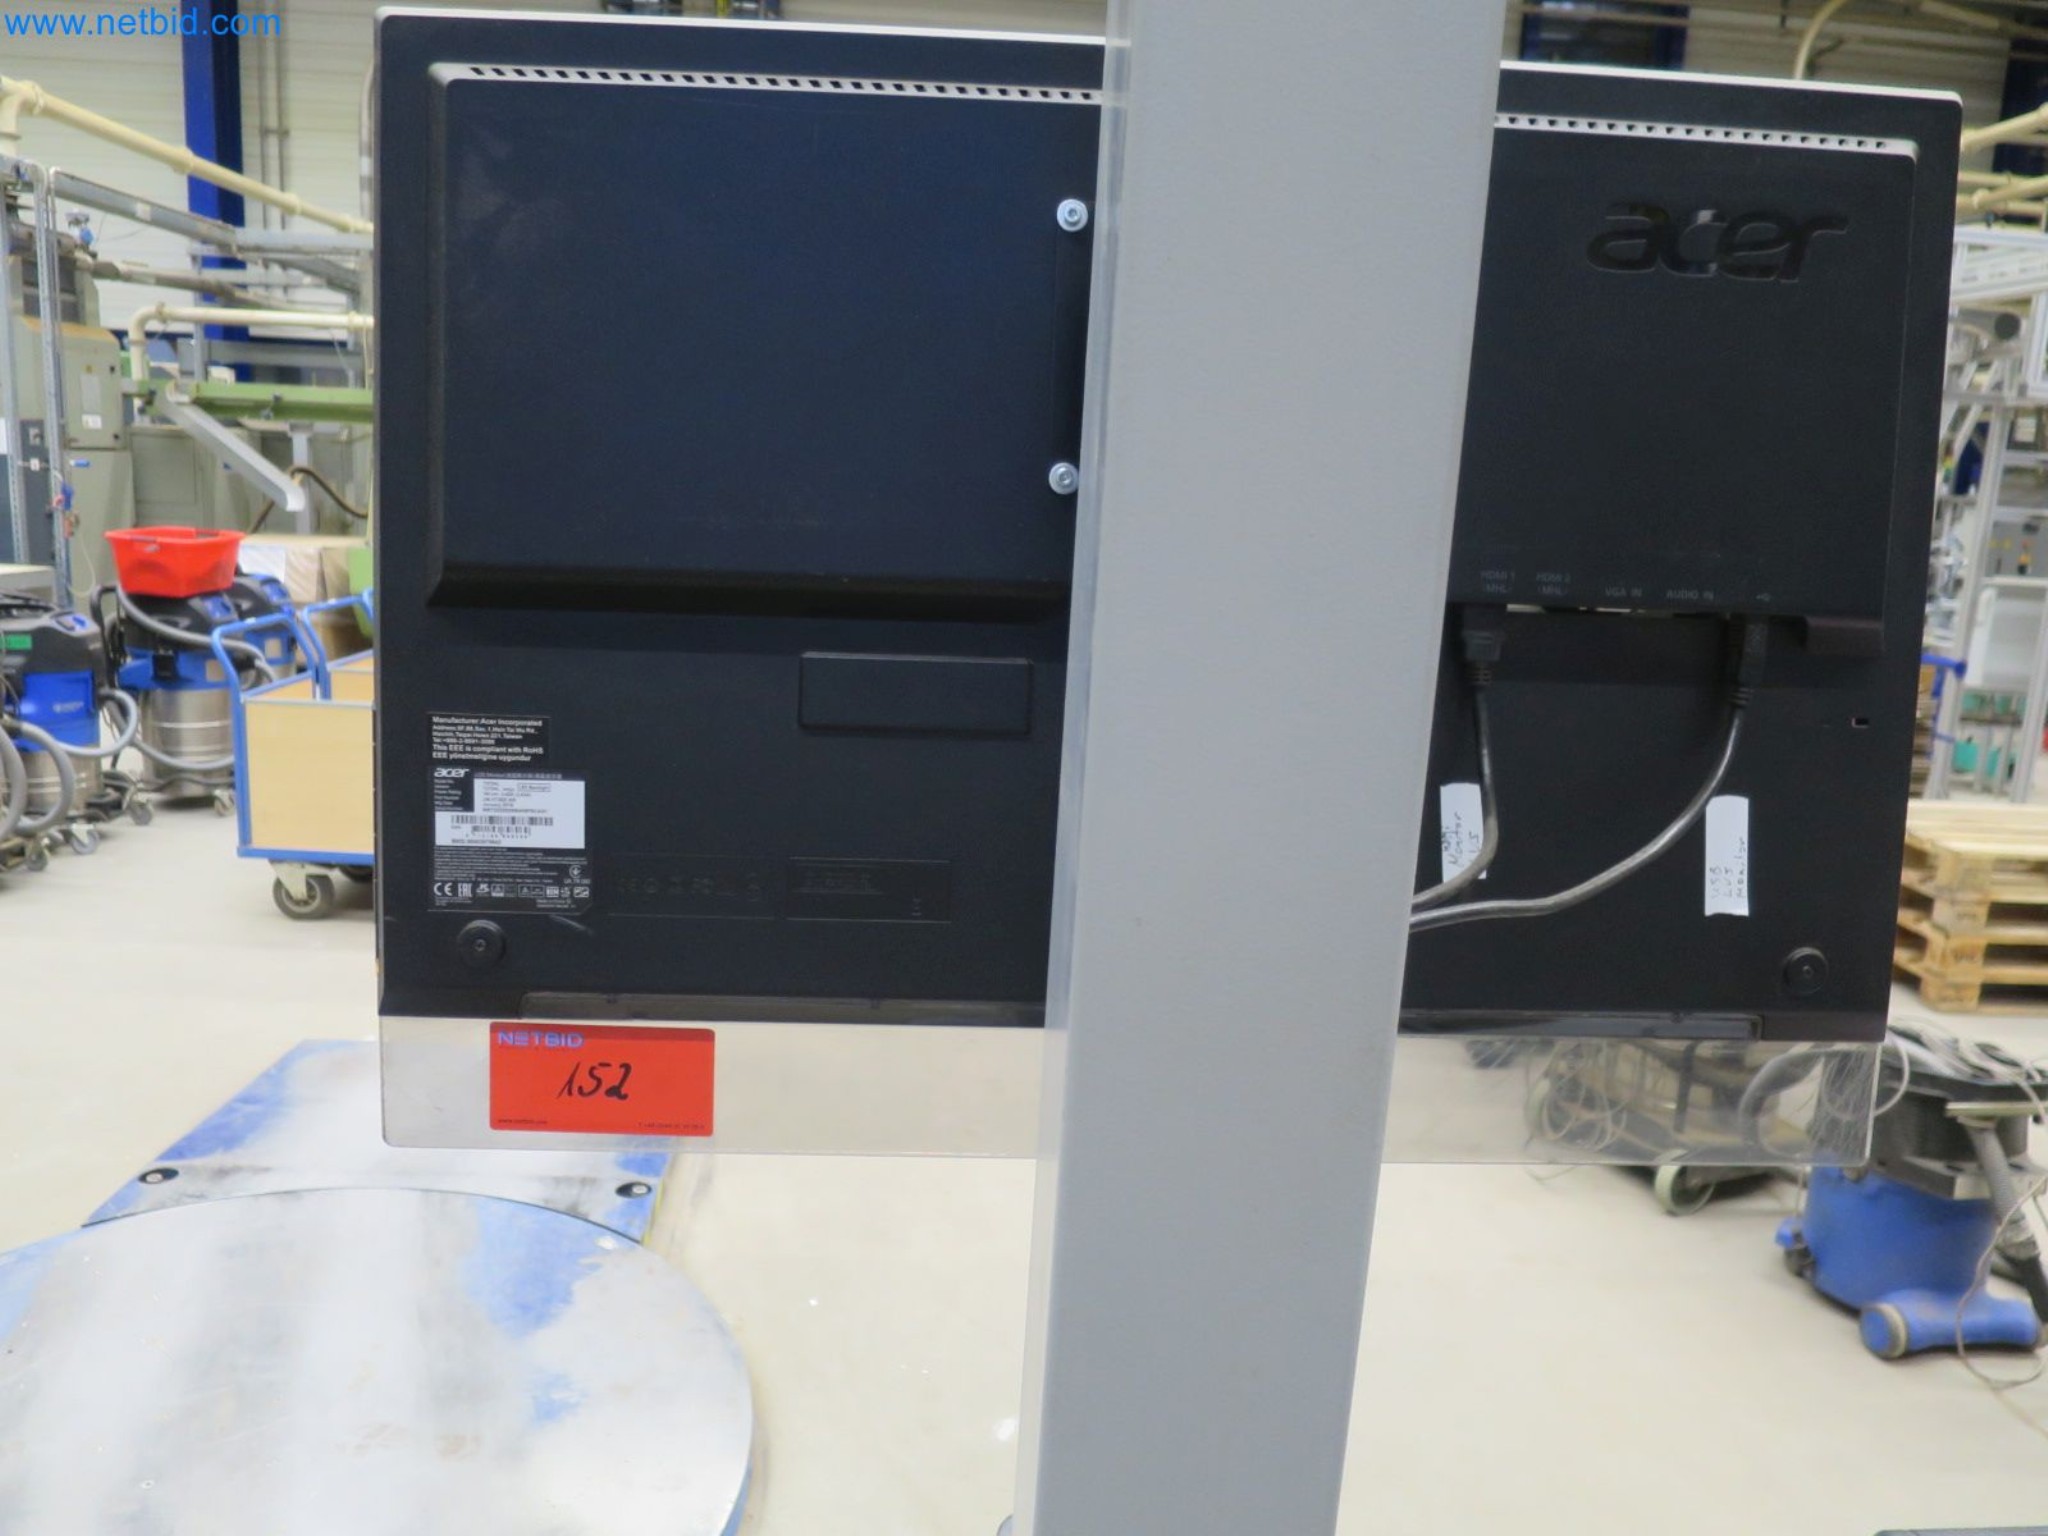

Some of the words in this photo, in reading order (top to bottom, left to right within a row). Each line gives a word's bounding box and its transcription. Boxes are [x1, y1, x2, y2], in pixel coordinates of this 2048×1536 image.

[1586, 202, 1850, 283] acer
[1605, 586, 1627, 597] VGA
[1631, 587, 1642, 598] IN
[1666, 589, 1699, 600] AUDIO
[434, 767, 470, 777] acer
[498, 1031, 584, 1047] NETBID
[557, 1061, 632, 1100] 152
